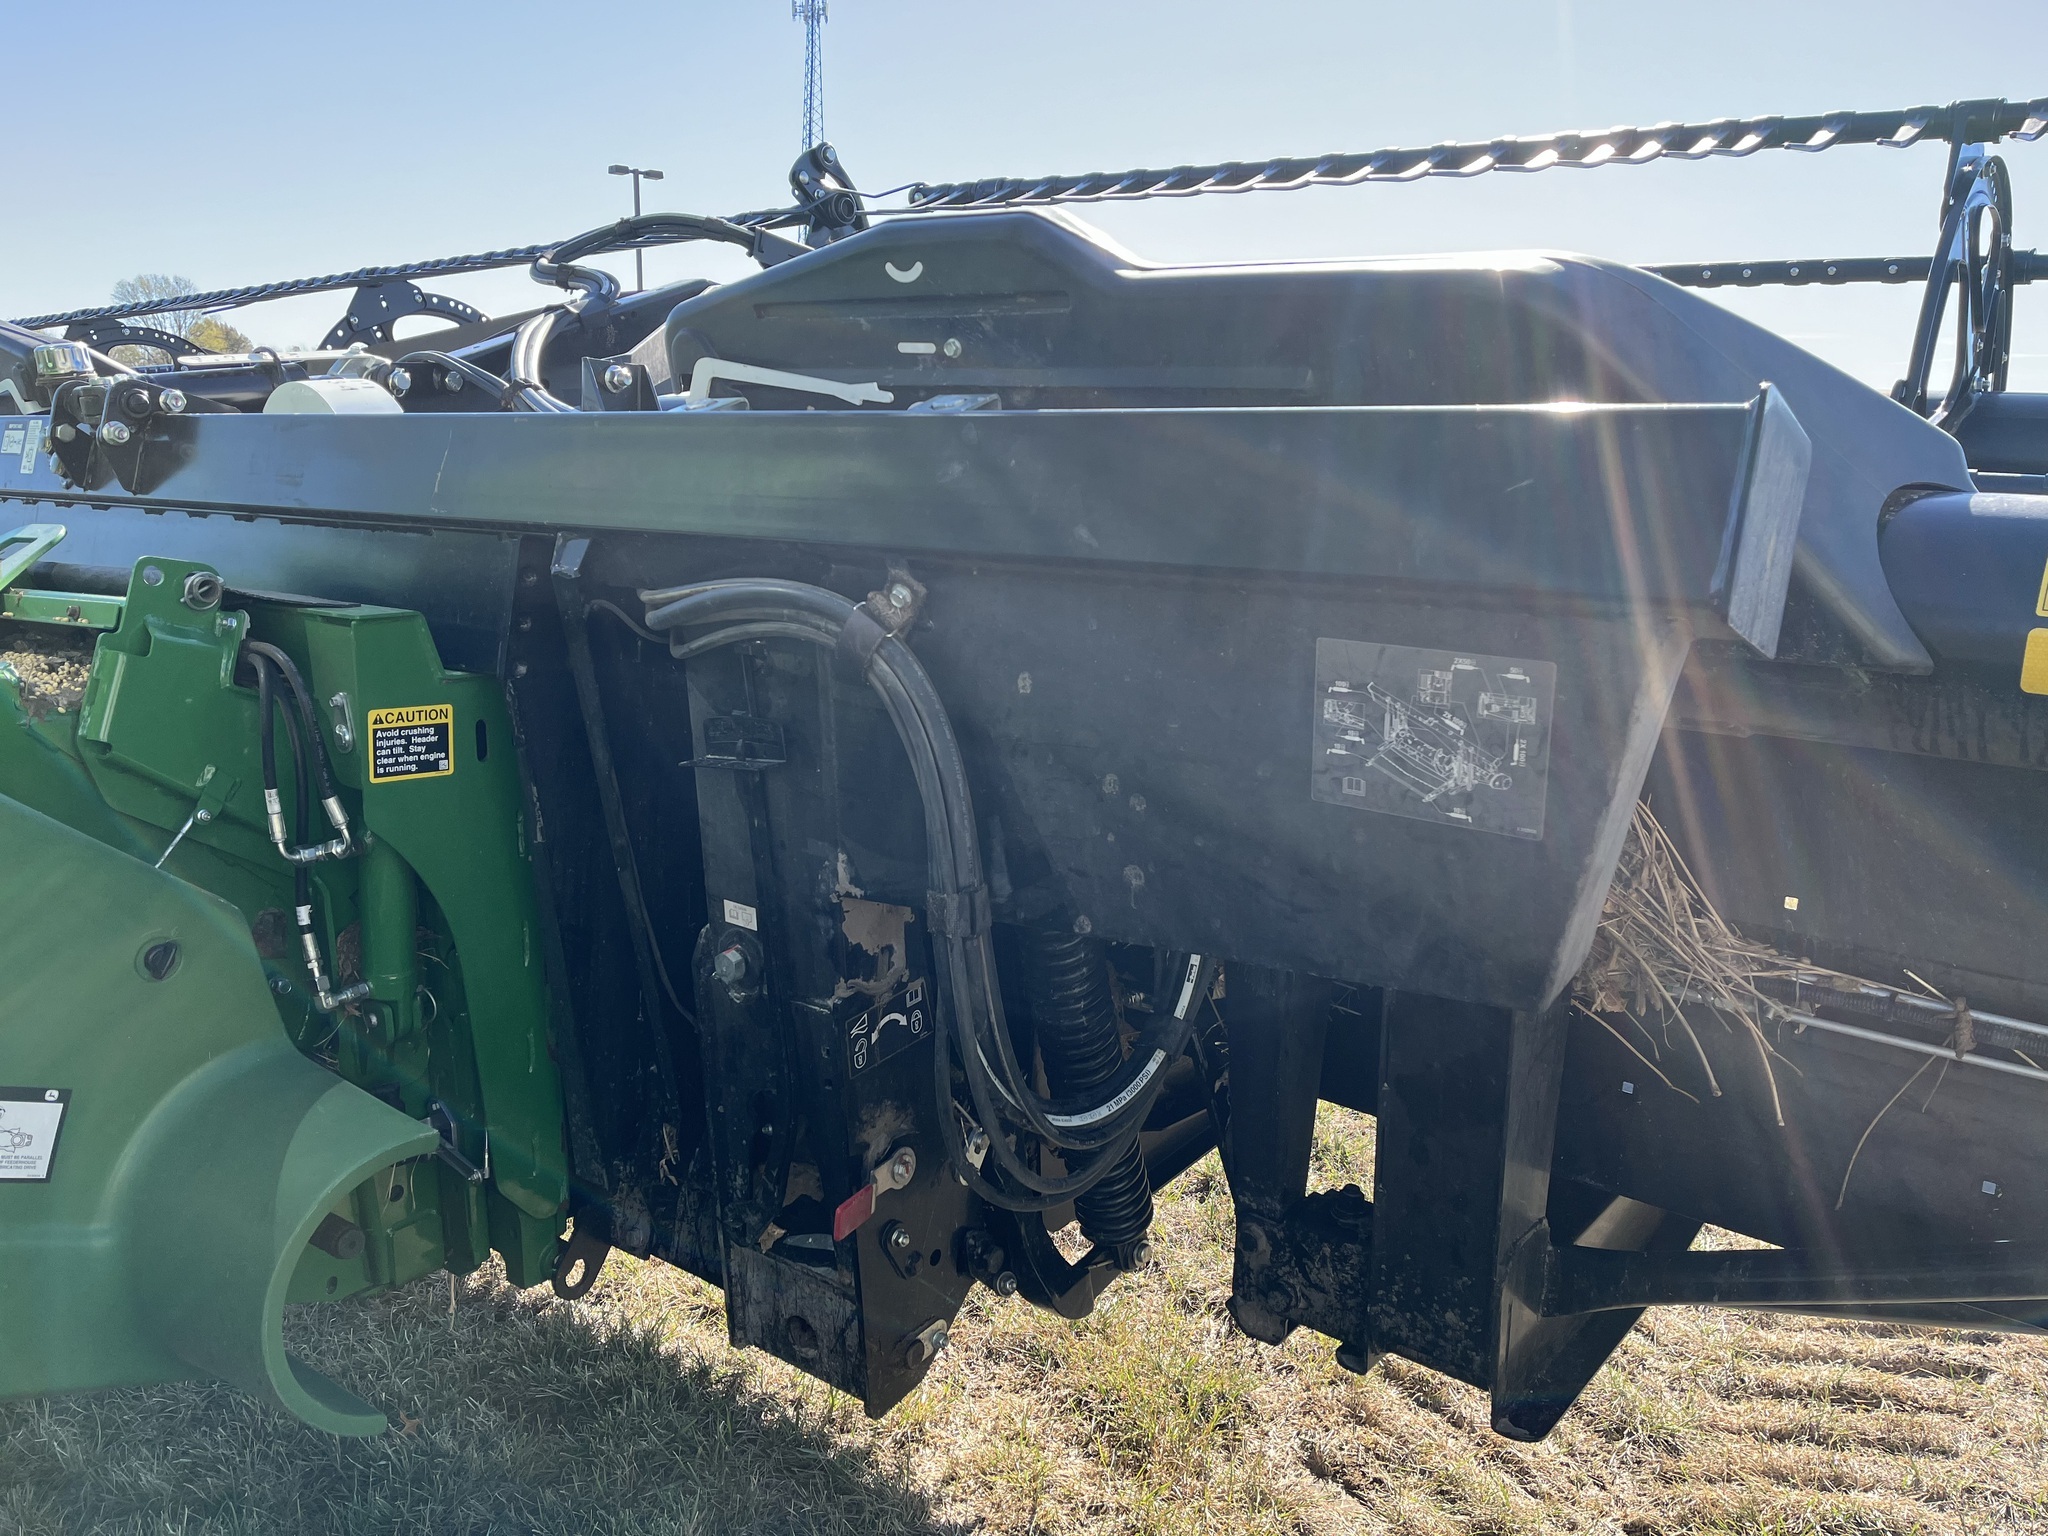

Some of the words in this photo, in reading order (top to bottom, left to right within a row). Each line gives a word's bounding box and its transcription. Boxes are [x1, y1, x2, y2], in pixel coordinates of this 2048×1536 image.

[385, 708, 448, 724] CAUTION
[376, 729, 399, 738] Avoid
[401, 727, 434, 736] crushing
[376, 738, 407, 748] injuries.
[412, 735, 439, 744] Header
[409, 745, 426, 753] Stay
[376, 757, 396, 765] clear
[420, 752, 445, 761] engine
[377, 766, 384, 774] is
[385, 763, 418, 772] running.
[1106, 1103, 1115, 1112] 21
[1114, 1095, 1127, 1108] MPa
[1126, 1081, 1141, 1098] (3000
[1140, 1069, 1151, 1084] PSI)
